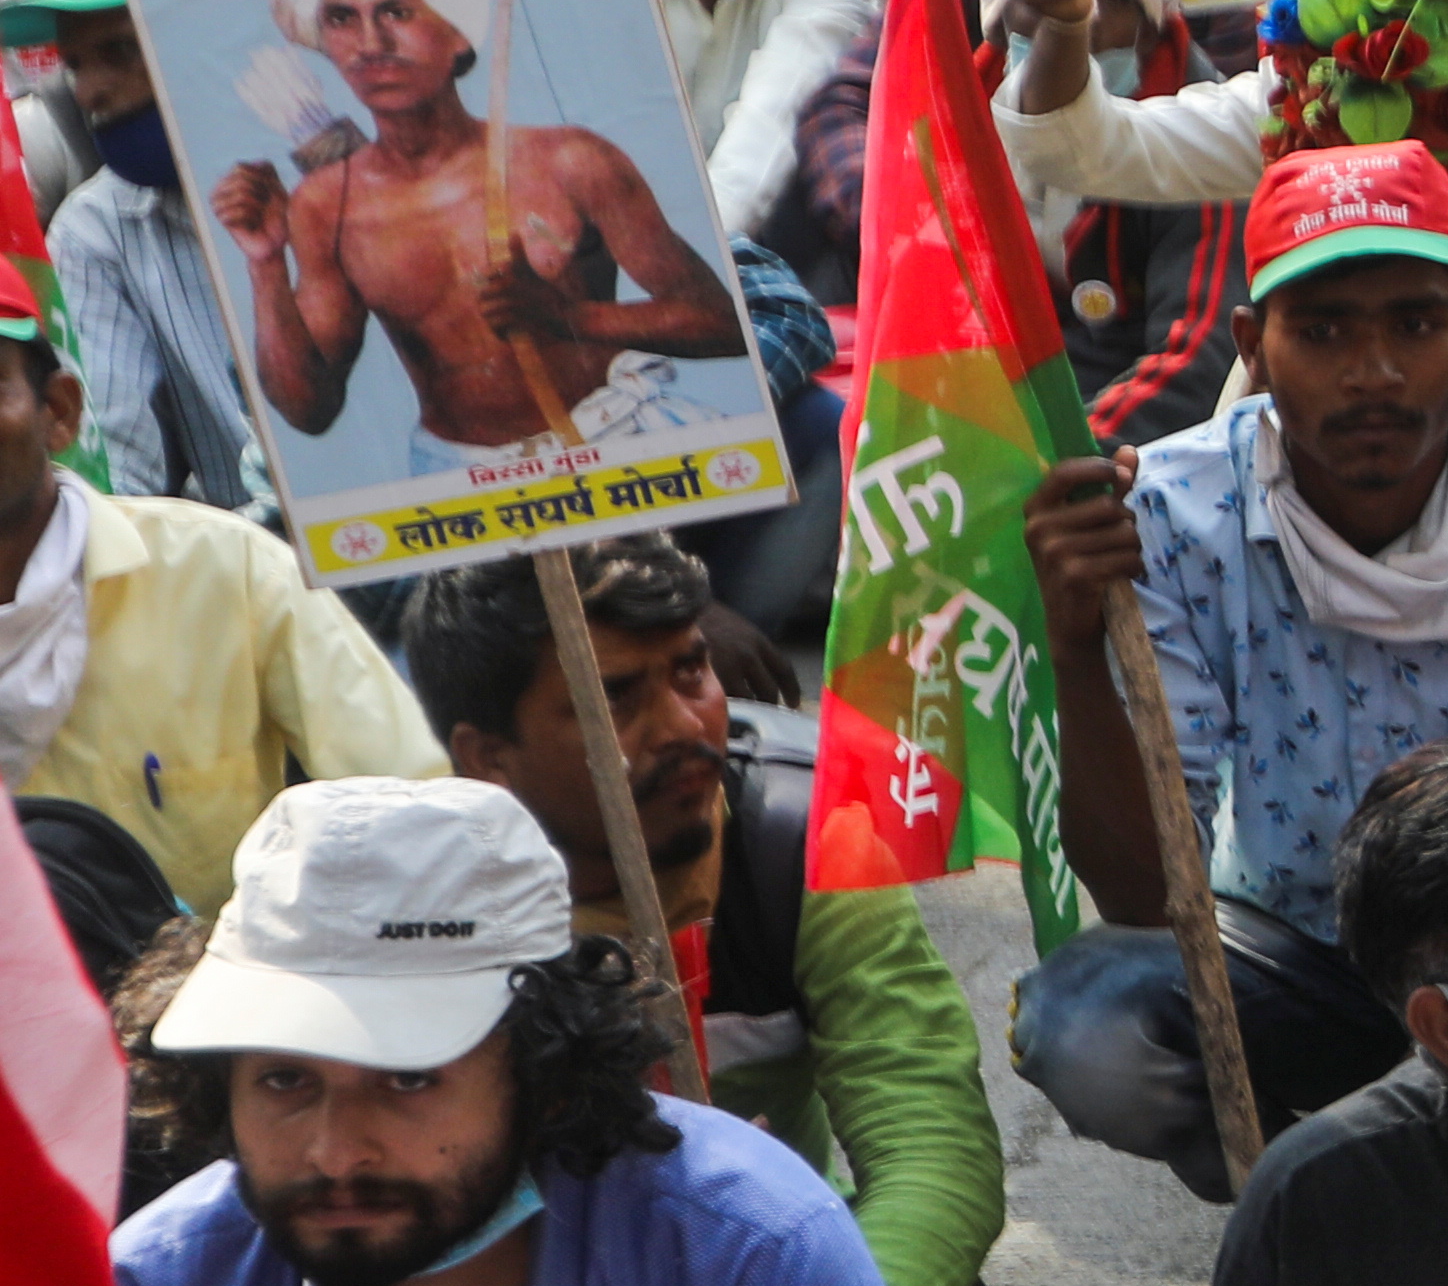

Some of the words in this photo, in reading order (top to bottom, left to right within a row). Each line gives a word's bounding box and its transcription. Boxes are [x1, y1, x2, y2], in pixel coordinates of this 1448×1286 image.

[394, 505, 488, 552] लोक
[495, 474, 598, 534] संघर्ष
[603, 454, 704, 510] मोर्चा
[376, 921, 425, 939] JUST
[428, 920, 458, 938] DO
[460, 920, 477, 938] IT
